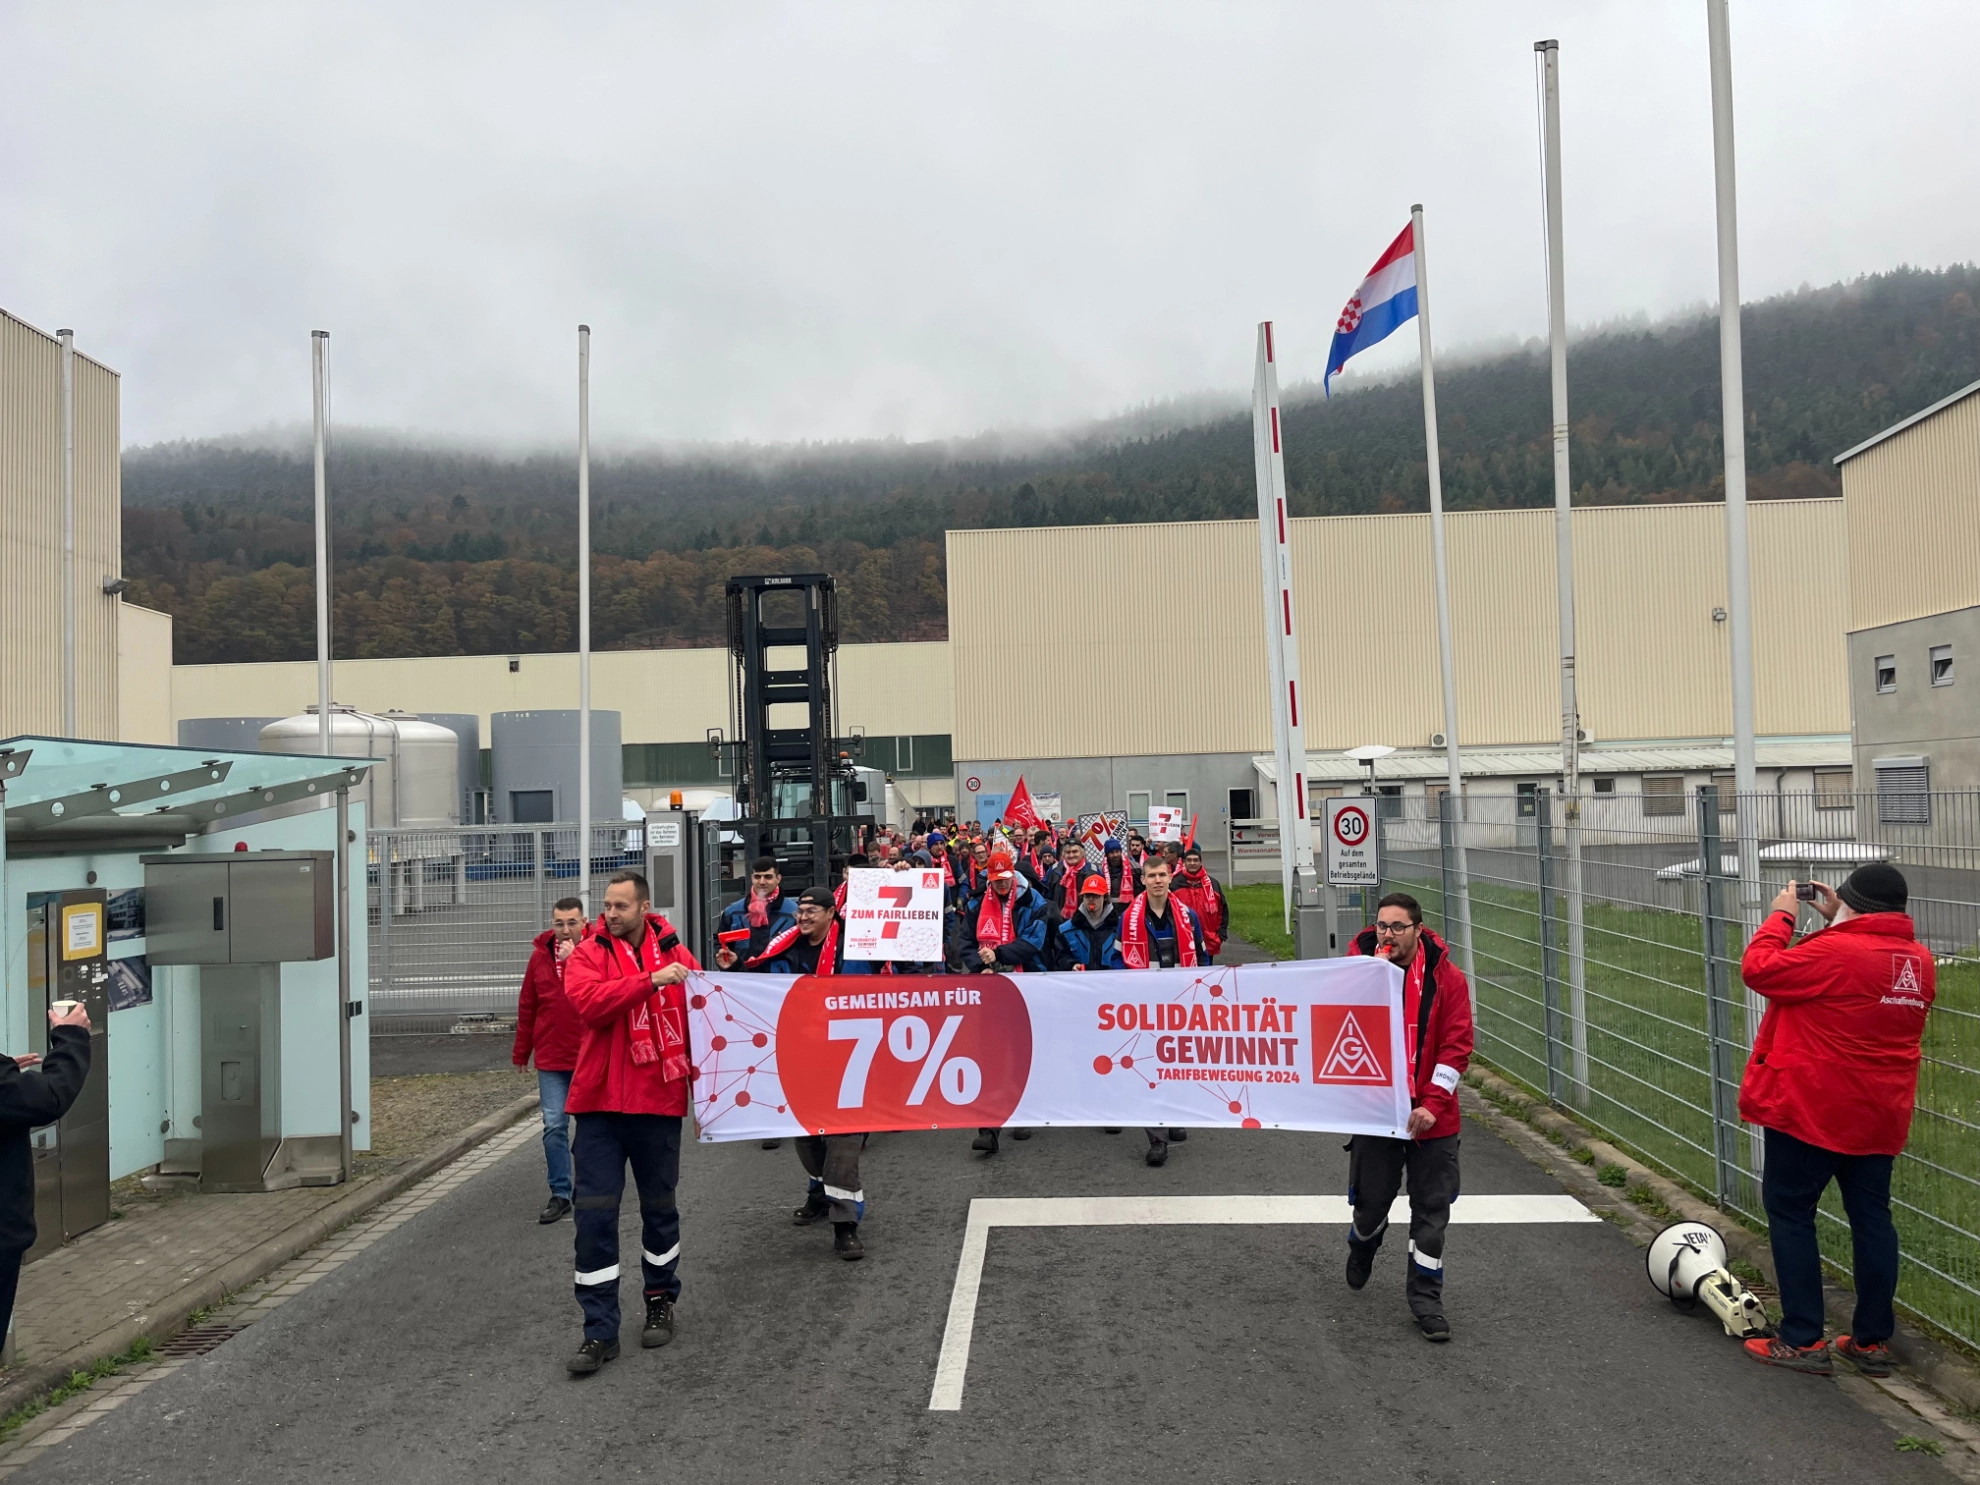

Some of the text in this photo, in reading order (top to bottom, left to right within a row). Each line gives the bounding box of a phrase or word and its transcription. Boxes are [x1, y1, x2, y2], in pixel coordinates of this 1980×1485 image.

[970, 780, 978, 788] 30
[1158, 813, 1171, 833] 7
[1341, 817, 1361, 835] 30
[1340, 849, 1364, 857] Auf dem
[1338, 861, 1367, 869] gesamten
[1330, 871, 1376, 880] Betriebsgelände
[850, 909, 939, 920] ZUM FAIRLIEBEN
[877, 886, 913, 939] 7
[825, 987, 982, 1010] GEMEINSAM FÜR
[1097, 997, 1298, 1033] SOLIDARITÄT
[1156, 1035, 1299, 1067] GEWINNT
[827, 1014, 982, 1109] 7%
[1156, 1067, 1300, 1084] TARIFBEWEGUNG 2024
